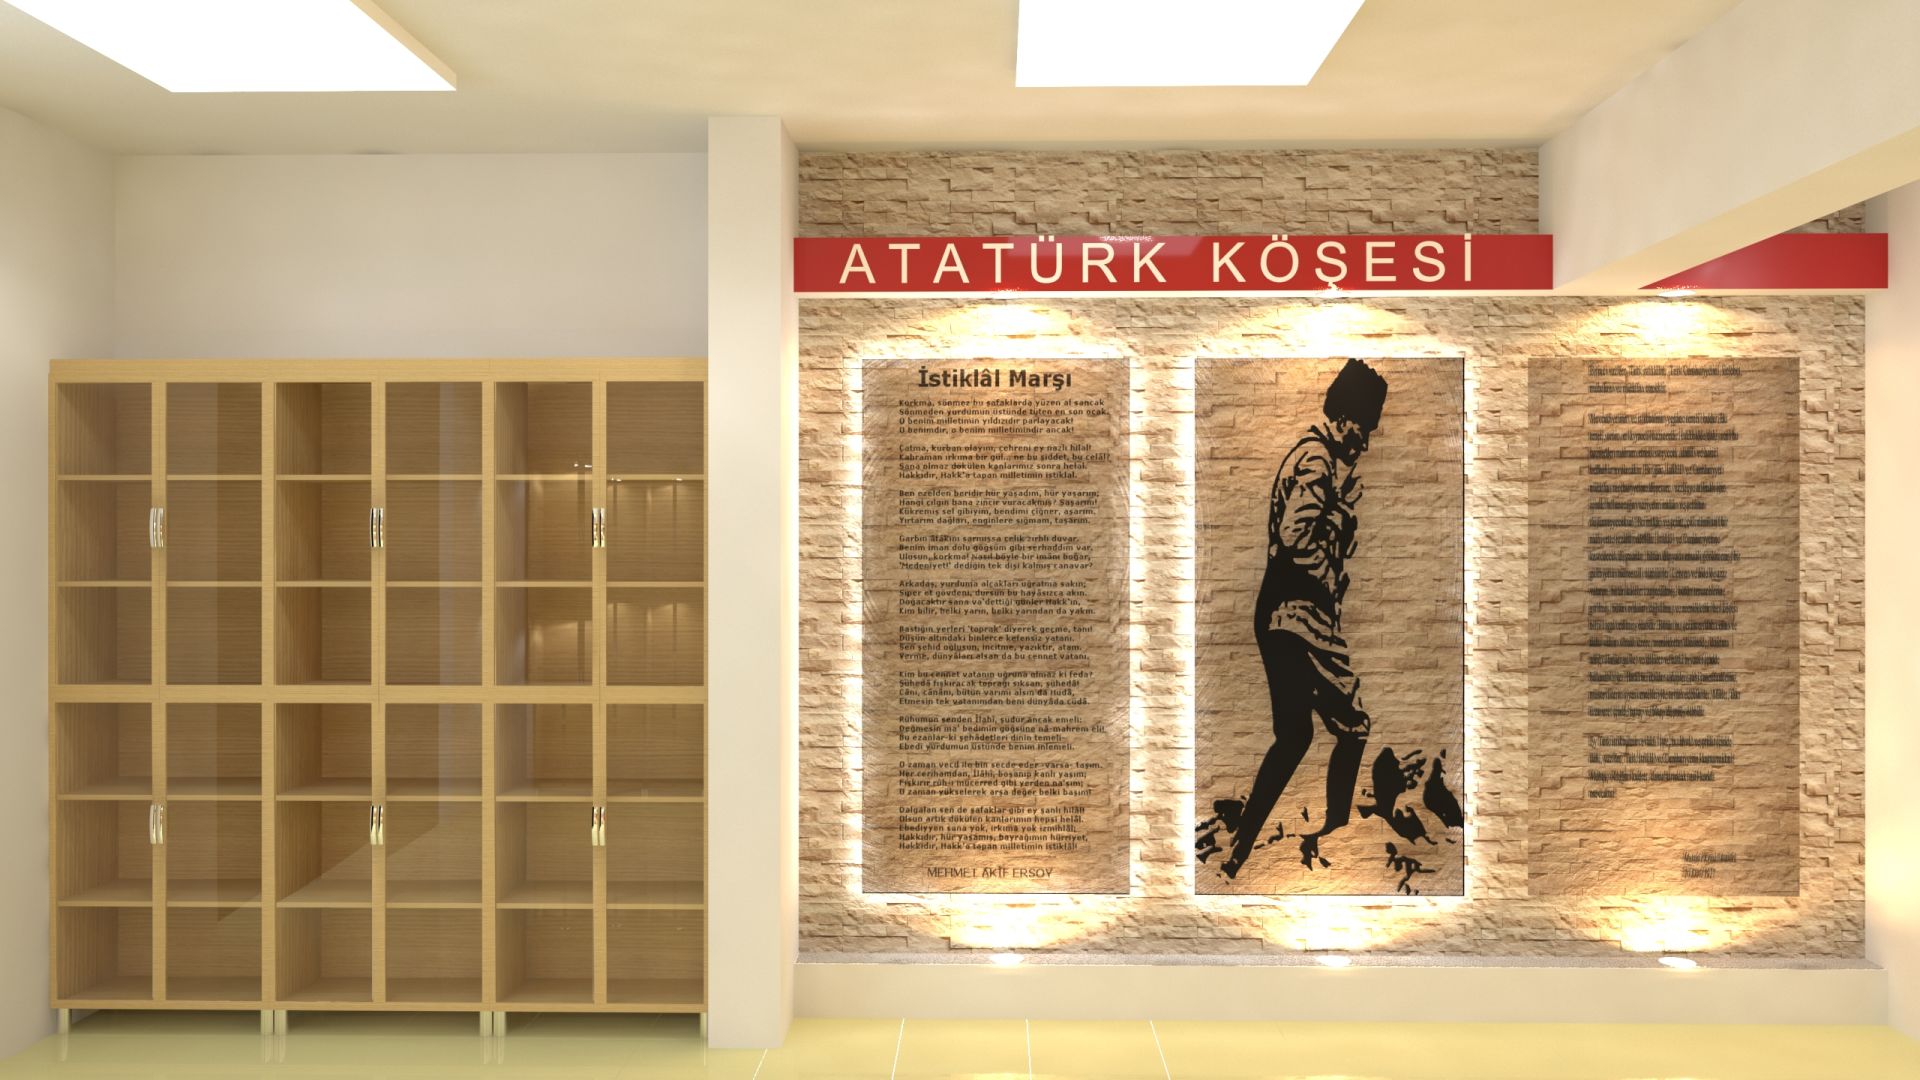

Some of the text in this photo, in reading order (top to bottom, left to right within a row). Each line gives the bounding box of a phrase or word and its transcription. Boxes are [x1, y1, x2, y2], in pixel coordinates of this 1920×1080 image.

[839, 233, 1472, 292] ATATÜRK KÖŞESİ
[918, 366, 1072, 390] İstiklâl Marşı
[899, 489, 915, 497] Ben
[988, 561, 1002, 569] tek
[899, 606, 915, 614] Kim
[957, 806, 967, 814] de
[1012, 867, 1054, 878] ERSOY
